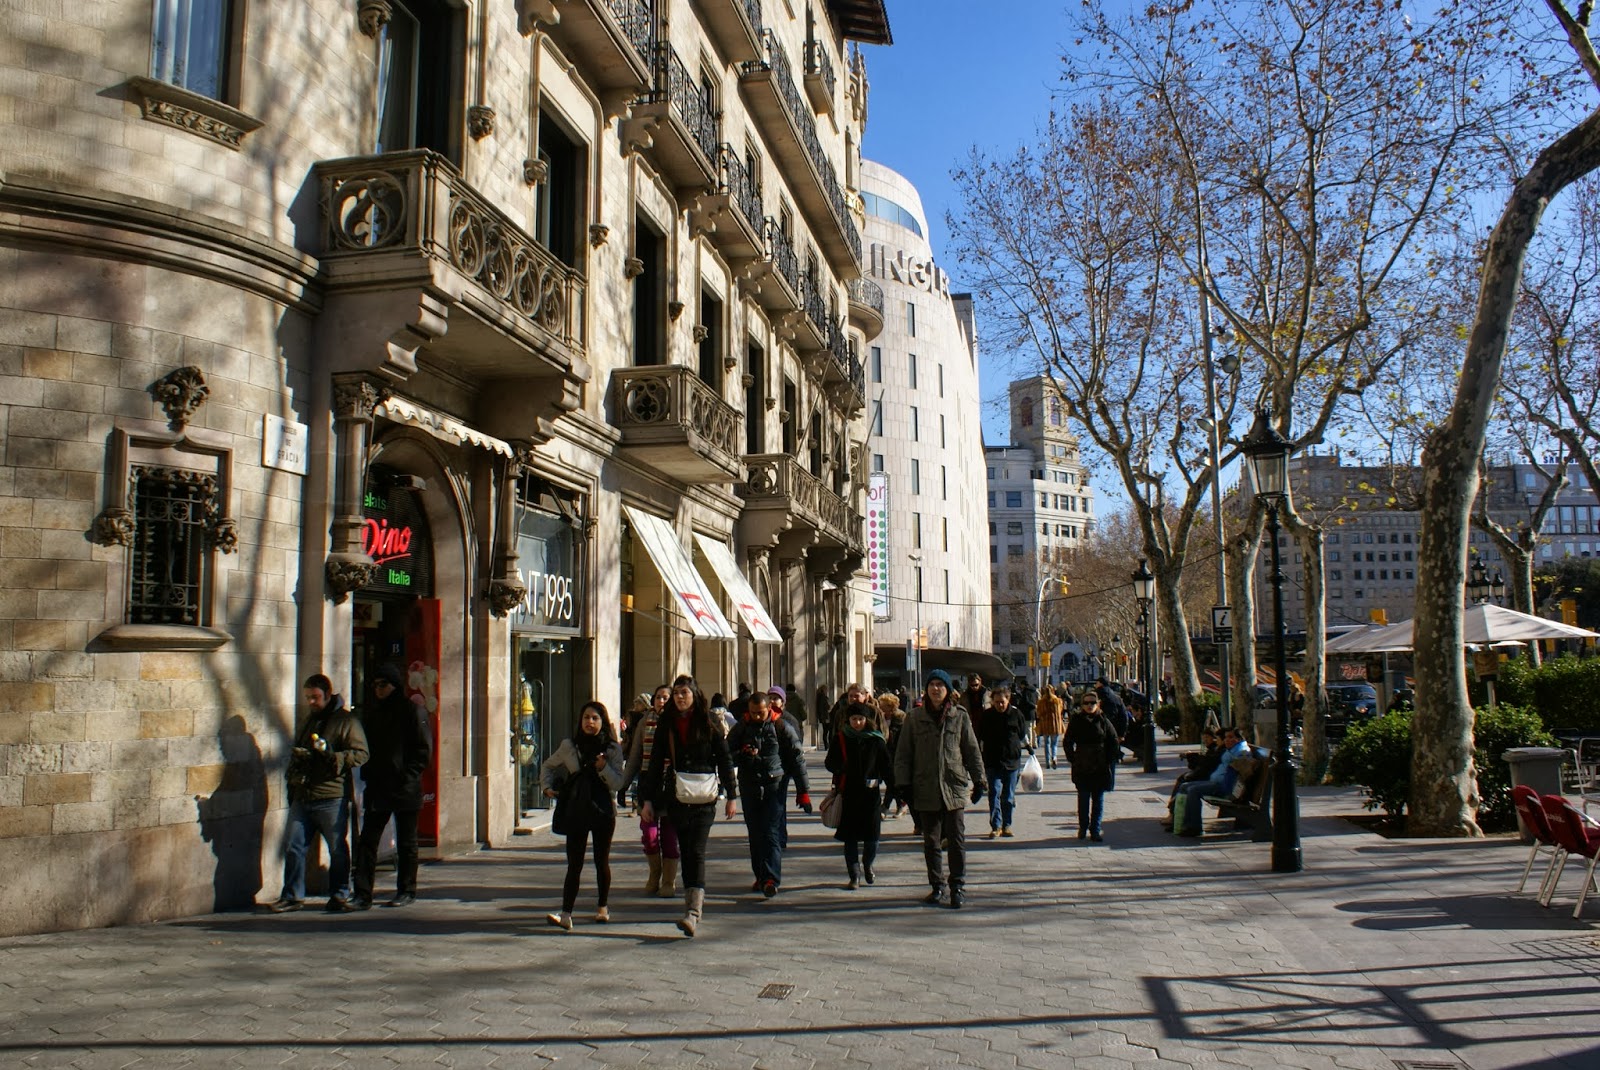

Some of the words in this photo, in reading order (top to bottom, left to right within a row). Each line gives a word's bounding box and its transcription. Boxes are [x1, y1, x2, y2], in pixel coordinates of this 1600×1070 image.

[364, 492, 387, 510] elats
[361, 518, 412, 557] Dino
[388, 568, 411, 586] Italia
[543, 573, 573, 620] 1995
